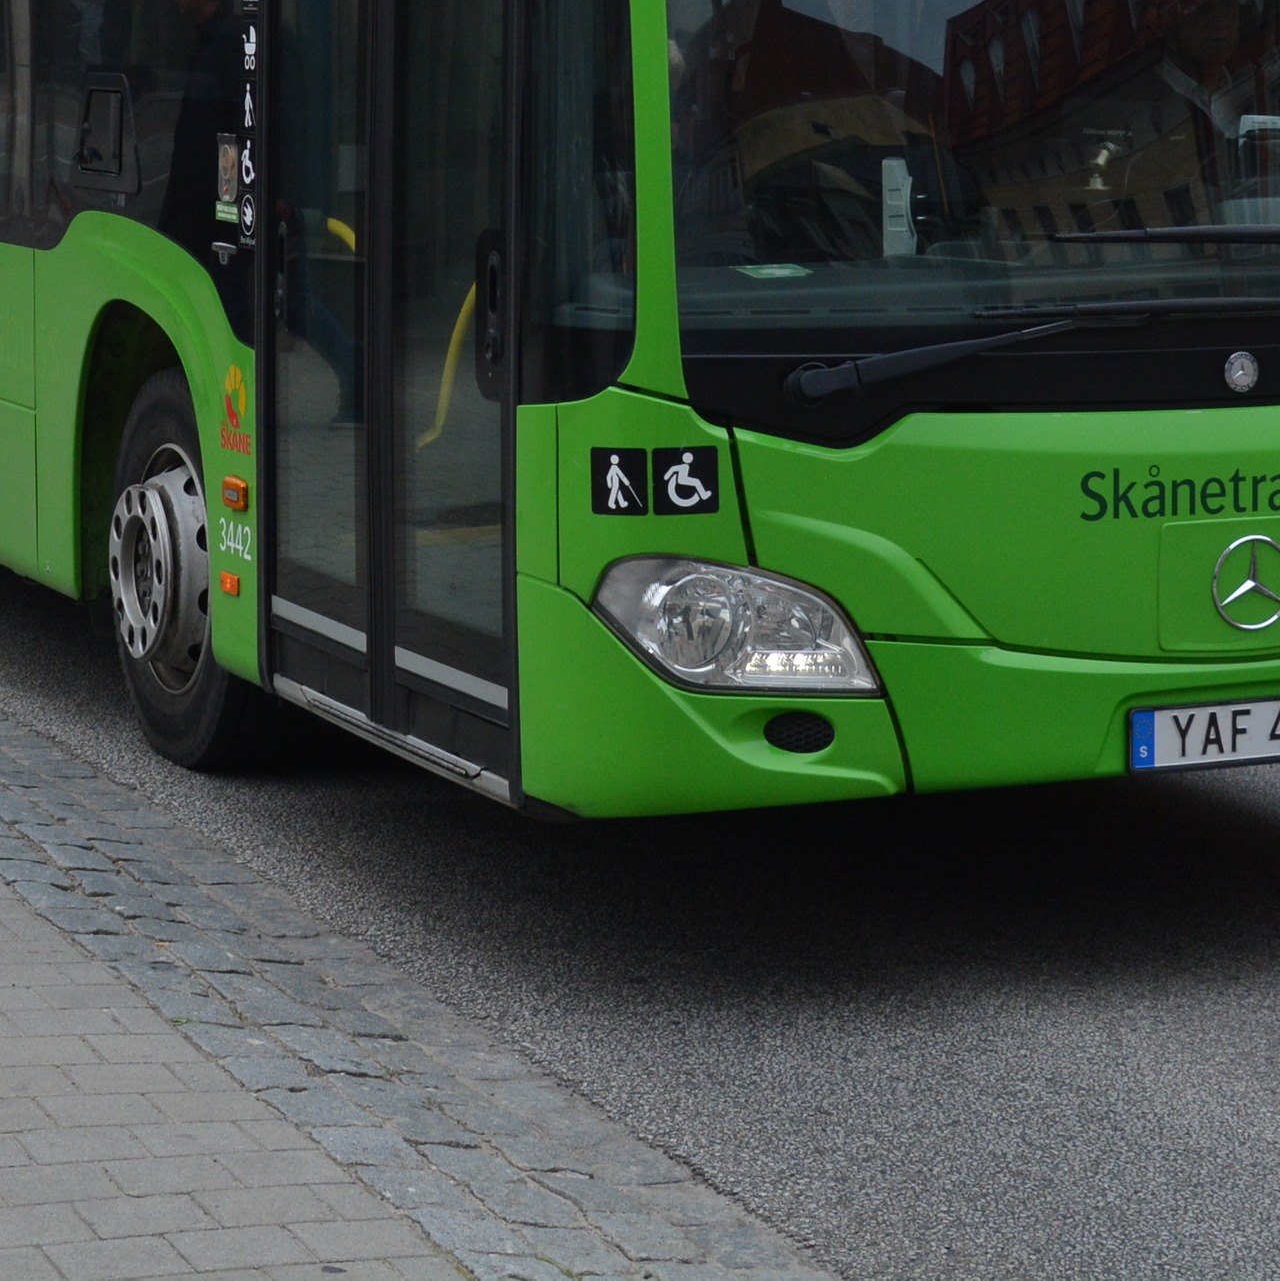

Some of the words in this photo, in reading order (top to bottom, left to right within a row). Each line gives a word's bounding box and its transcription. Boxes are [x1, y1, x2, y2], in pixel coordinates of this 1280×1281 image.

[219, 517, 252, 561] 3442
[1139, 745, 1148, 758] S
[1172, 709, 1248, 757] YAF
